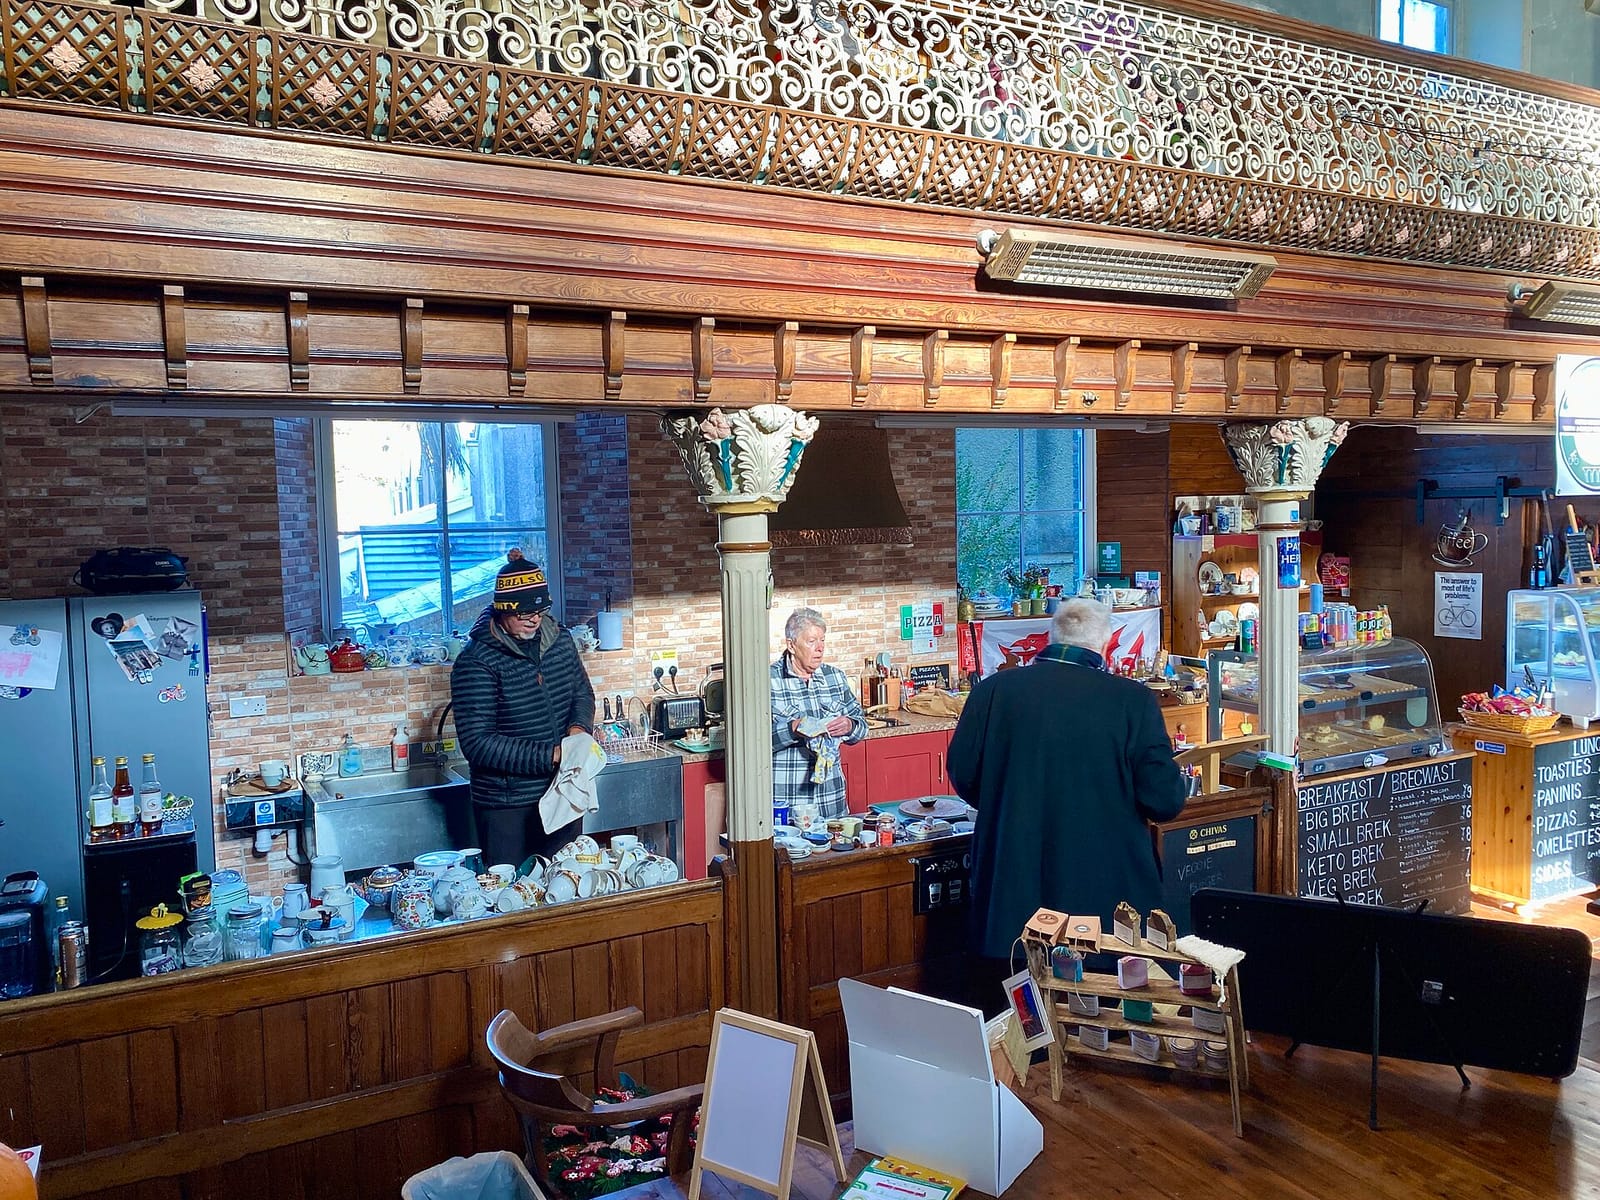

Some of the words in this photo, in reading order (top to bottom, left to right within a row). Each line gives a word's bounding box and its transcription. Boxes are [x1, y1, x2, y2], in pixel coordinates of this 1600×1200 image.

[1440, 576, 1450, 584] The
[1450, 577, 1470, 585] answer
[1462, 585, 1475, 593] life's
[904, 615, 942, 628] PIZZA
[1537, 758, 1591, 784] TOASTIES
[1298, 777, 1374, 809] BREAKFAST
[1391, 762, 1457, 792] BRECWAST
[1537, 782, 1582, 807] PANINIS
[1306, 810, 1328, 831] BIG
[1332, 801, 1369, 826] BREK
[1536, 810, 1577, 835] PIZZAS
[1200, 824, 1227, 837] CHIVAS
[1307, 828, 1354, 853] SMALL
[1357, 819, 1391, 844] BREK
[1536, 827, 1600, 858] OMELETTES
[1307, 852, 1345, 877] KETO
[1352, 843, 1385, 867] BREK
[1535, 860, 1571, 884] SIDES
[1307, 878, 1337, 897] VEG
[1343, 866, 1377, 891] BREK
